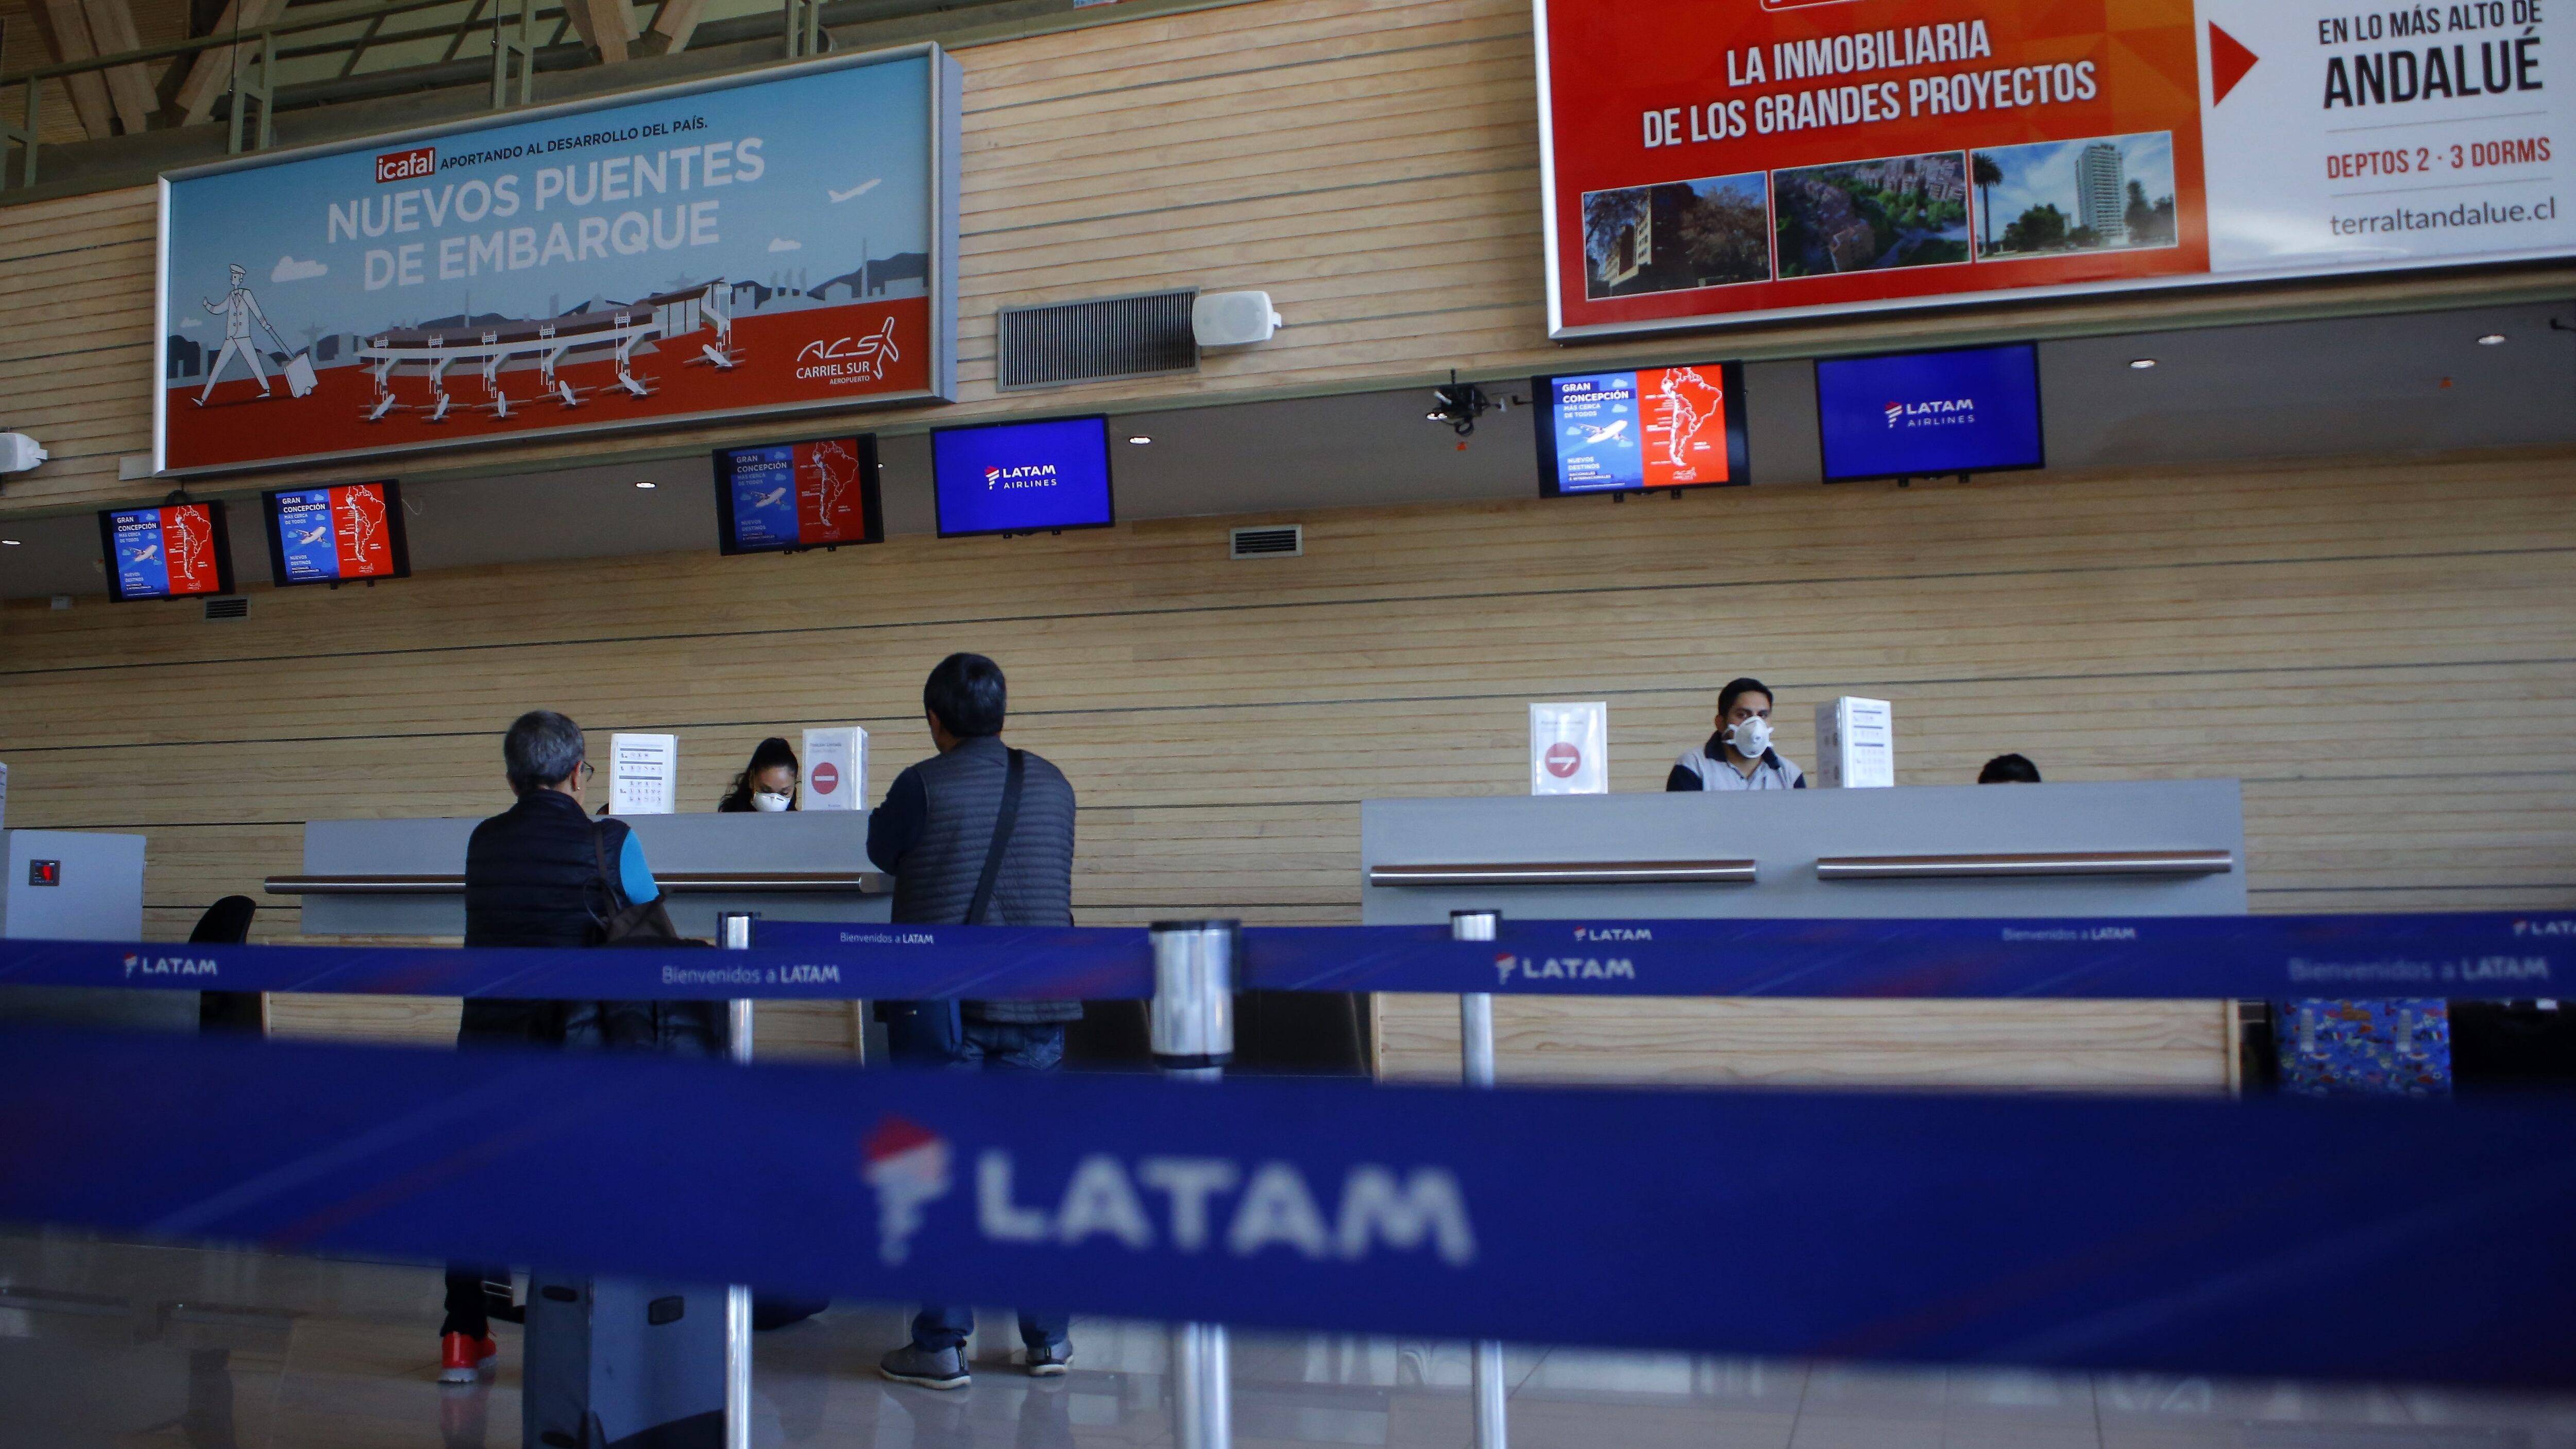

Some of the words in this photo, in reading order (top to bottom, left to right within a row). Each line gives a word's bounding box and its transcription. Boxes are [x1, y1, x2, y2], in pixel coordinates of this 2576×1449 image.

[2319, 19, 2348, 45] EN
[2355, 15, 2383, 41] LO
[2390, 4, 2441, 38] MÁS
[2448, 2, 2504, 32] ALTO
[2513, 0, 2543, 26] DE
[1727, 46, 1766, 87] LA
[1773, 20, 1991, 81] INMOBILIARIA
[2323, 26, 2543, 109] ANDALUÉ
[1643, 109, 1682, 148] DE
[1690, 99, 1747, 144] LOS
[1755, 82, 1900, 136] GRANDES
[1909, 60, 2097, 117] PROYECTOS
[440, 146, 523, 170] APORTANDO
[527, 141, 544, 156] AL
[547, 127, 638, 152] DESARROLLO
[642, 124, 669, 137] DEL
[673, 115, 708, 132] PAÍS.
[378, 150, 434, 180] icafal
[2327, 149, 2410, 179] DEPTOS
[2417, 147, 2430, 172] 2
[2450, 144, 2464, 169] 3
[2472, 137, 2551, 167] DORMS
[328, 175, 519, 244] NUEVOS
[536, 137, 765, 211] PUENTES
[2330, 196, 2556, 236] terraltandalue.cl
[364, 243, 424, 292] DE
[439, 200, 720, 281] EMBARQUE
[797, 334, 883, 362] ACS
[796, 364, 844, 379] CARRIEL
[846, 361, 870, 374] SUR
[829, 375, 870, 385] AEROPUERTO
[1562, 382, 1591, 393] GRAN
[1563, 390, 1629, 403] CONCEPCIÓN
[1906, 398, 1974, 415] LATAM
[1908, 414, 1975, 427] AIRLINES
[737, 461, 787, 473] CONCEPCIÓN
[1003, 464, 1057, 478] LATAM
[1004, 478, 1057, 489] AIRLINES
[283, 502, 326, 513] CONCEPCIÓN
[118, 521, 157, 532] CONCEPCIÓN
[840, 932, 892, 943] Bienvenidos
[895, 935, 901, 944] a
[903, 933, 934, 945] LATAM
[1589, 928, 1652, 941] LATAM
[2091, 927, 2136, 940] LATAM
[143, 957, 218, 975] LATAM
[662, 965, 760, 984] Bienvenidos
[766, 970, 775, 984] a
[780, 965, 840, 984] LATAM
[1522, 957, 1635, 980] LATAM
[2462, 957, 2549, 981] LATAM
[975, 1149, 1477, 1267] LATAM
